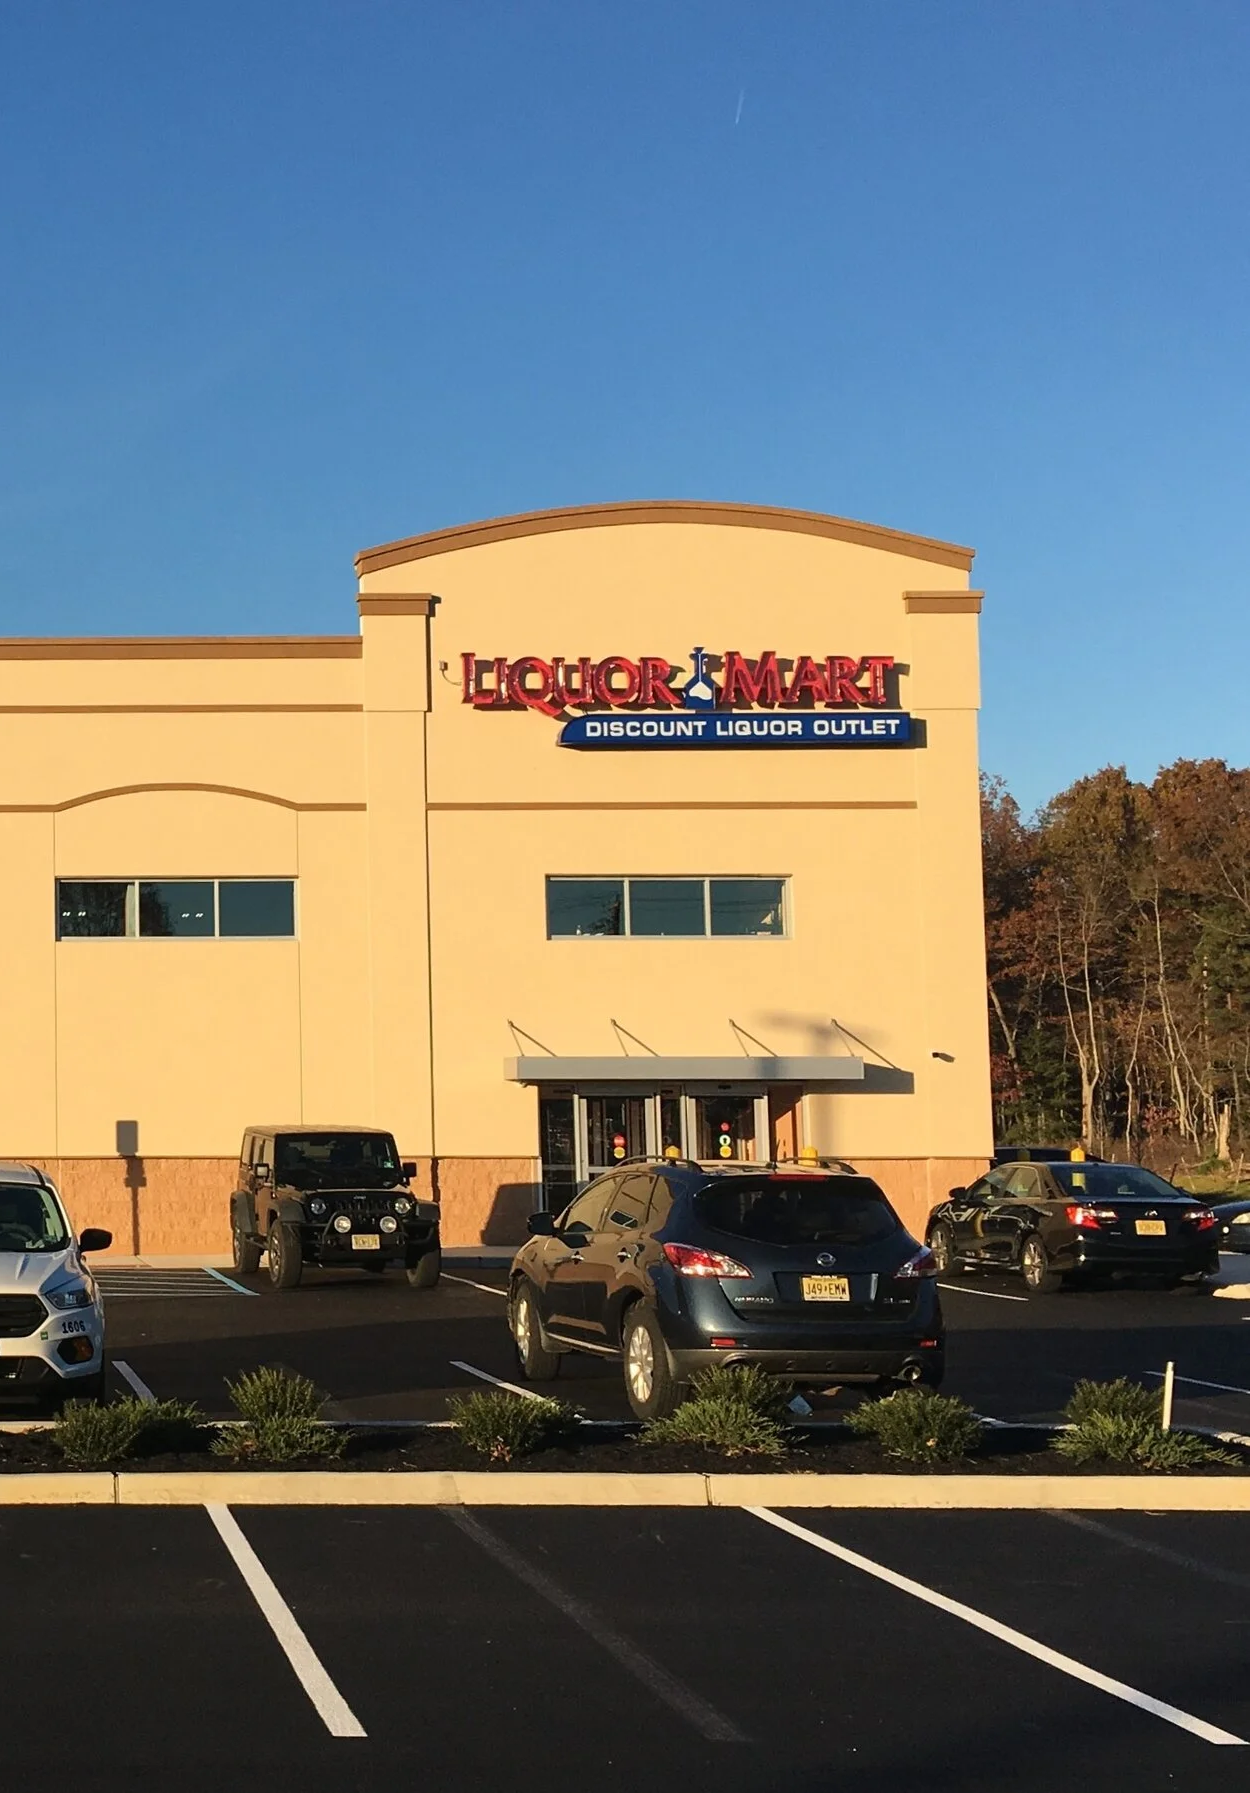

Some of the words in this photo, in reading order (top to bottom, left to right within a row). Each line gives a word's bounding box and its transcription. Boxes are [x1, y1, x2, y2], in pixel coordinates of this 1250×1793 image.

[461, 652, 683, 718] LIQUOR
[720, 650, 895, 704] MART
[585, 720, 707, 738] DISCOUNT
[716, 720, 803, 737] LIQUOR
[813, 719, 900, 736] OUTLET
